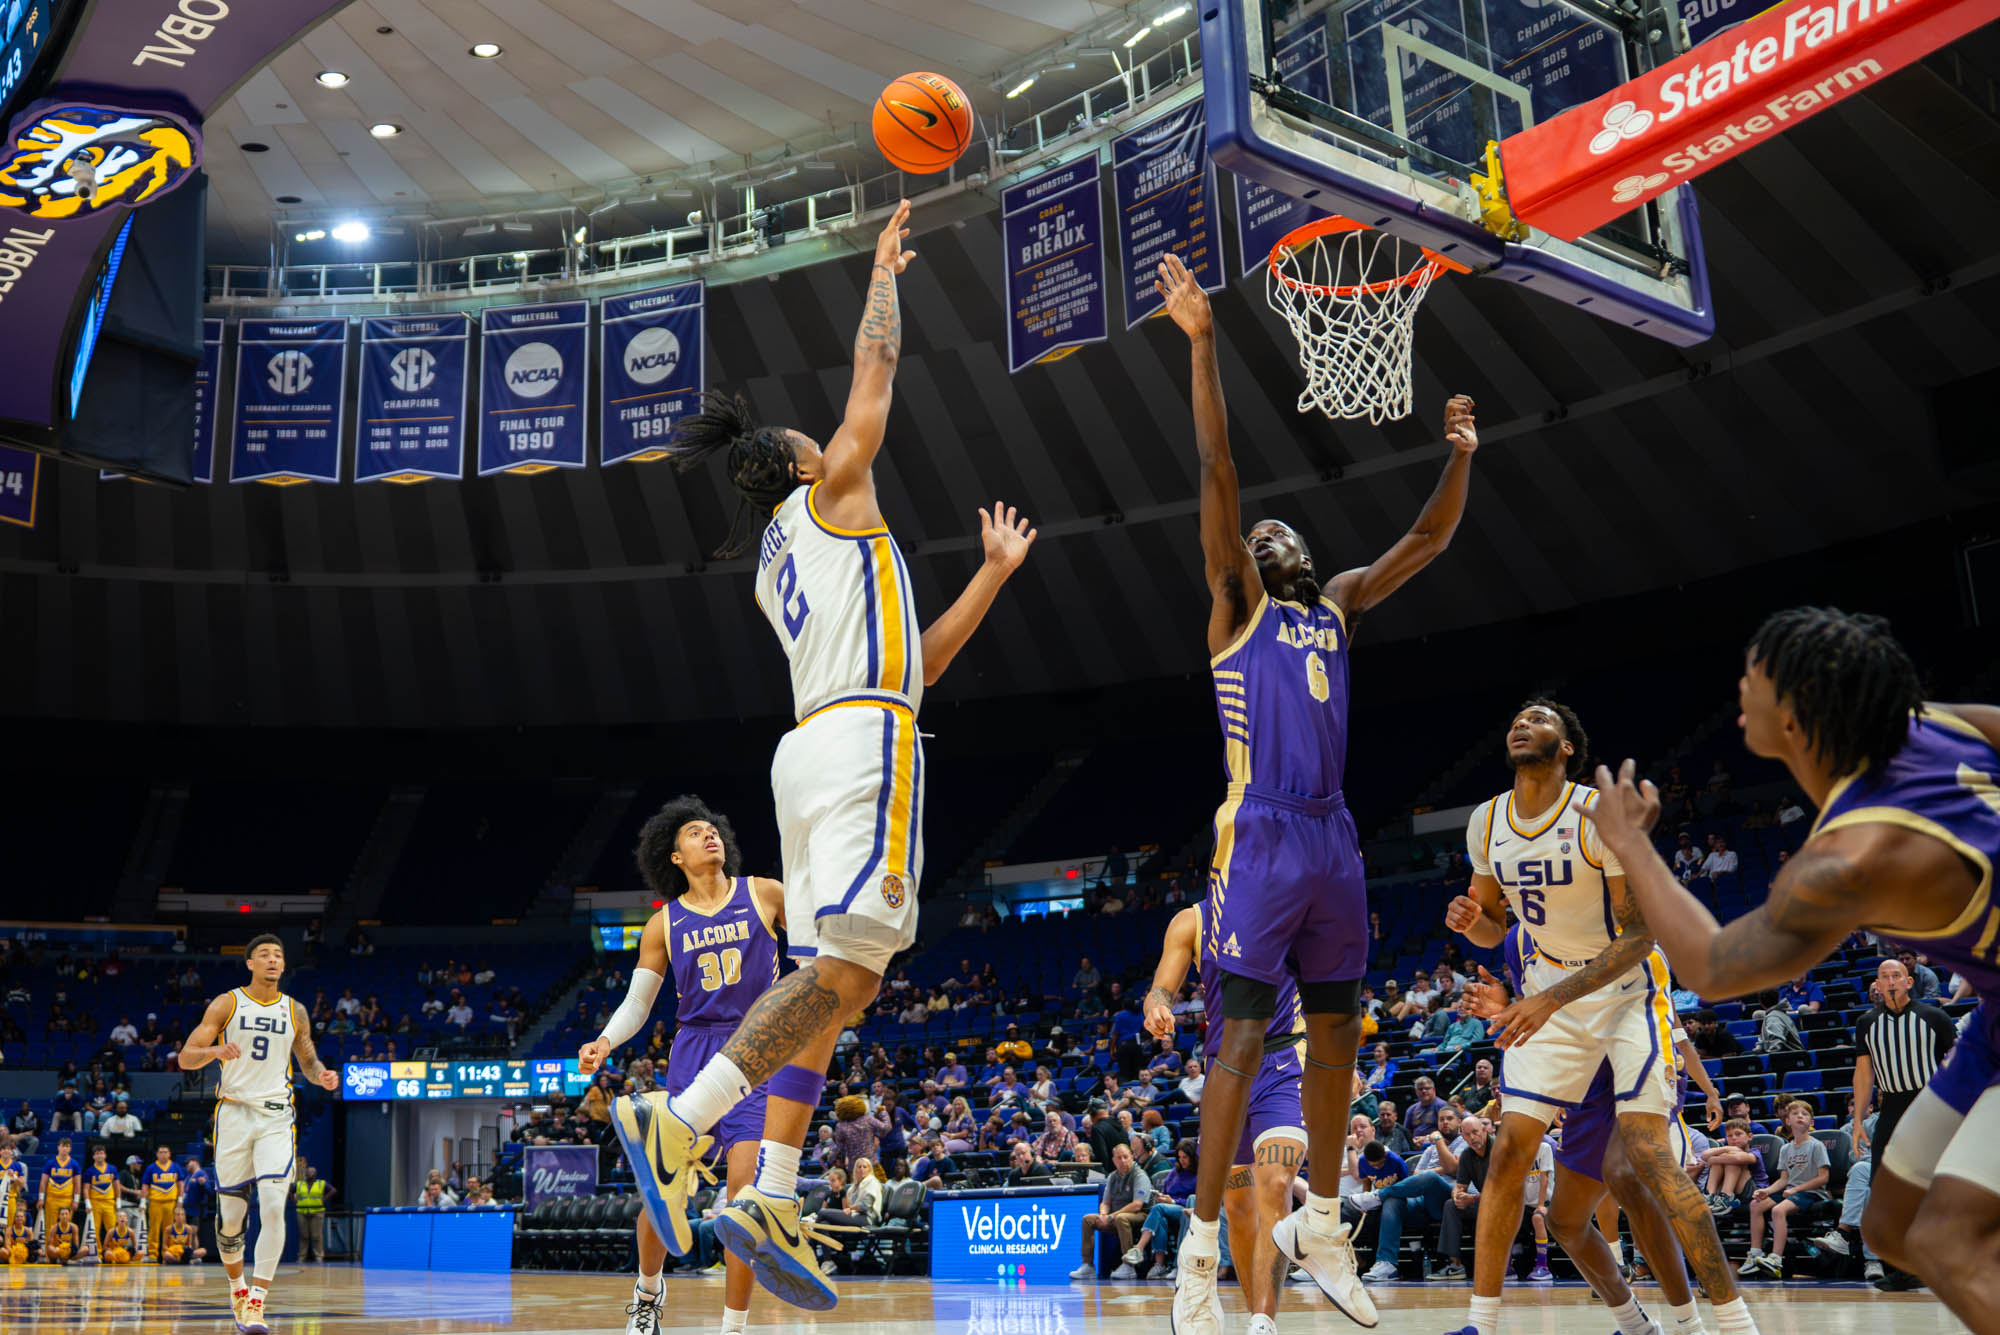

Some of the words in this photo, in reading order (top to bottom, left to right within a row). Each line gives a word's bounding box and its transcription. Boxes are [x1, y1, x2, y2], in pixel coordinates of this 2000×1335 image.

[1517, 6, 1575, 42] CHAMPIO
[1578, 29, 1604, 50] 2016
[1542, 48, 1568, 68] 2015
[1545, 64, 1571, 86] 2018
[1138, 152, 1189, 185] NATIONAL
[1026, 171, 1074, 198] GYMNASTICS
[1134, 160, 1196, 199] CHAMPIONS
[1040, 203, 1064, 219] COACH
[1248, 194, 1275, 215] BRYANT
[1257, 201, 1292, 224] FINNEGAN
[1022, 223, 1085, 264] BREAUX
[629, 294, 675, 310] VOLLEYBALL
[511, 311, 559, 323] VOLLEYBALL
[390, 347, 436, 392] SEC
[630, 351, 677, 372] NCAA
[267, 350, 314, 395] SEC
[511, 368, 561, 385] NCAA
[383, 398, 440, 409] CHAMPIONS
[620, 407, 651, 421] FINAL
[654, 400, 683, 415] FOUR
[500, 418, 531, 432] FINAL
[535, 416, 564, 428] FOUR
[508, 431, 554, 451] 1990
[776, 552, 810, 642] 2
[1276, 621, 1338, 651] ALCORN
[1305, 651, 1330, 703] 6
[1494, 859, 1573, 886] LSU
[1519, 888, 1546, 926] 6
[683, 920, 750, 953] ALCORN
[697, 947, 742, 992] 30
[240, 1016, 286, 1035] LSU
[251, 1035, 270, 1061] 9
[435, 1070, 445, 1082] 5
[457, 1065, 501, 1081] 11:43
[512, 1068, 522, 1080] 4
[536, 1063, 561, 1073] LSU
[396, 1080, 420, 1097] 66
[484, 1084, 493, 1095] 2
[51, 1168, 73, 1177] LSU
[91, 1173, 114, 1185] LSU
[152, 1172, 177, 1183] LSU
[962, 1203, 1067, 1250] Velocity
[969, 1244, 1004, 1254] CLINICAL
[1006, 1243, 1048, 1254] RESEARCH
